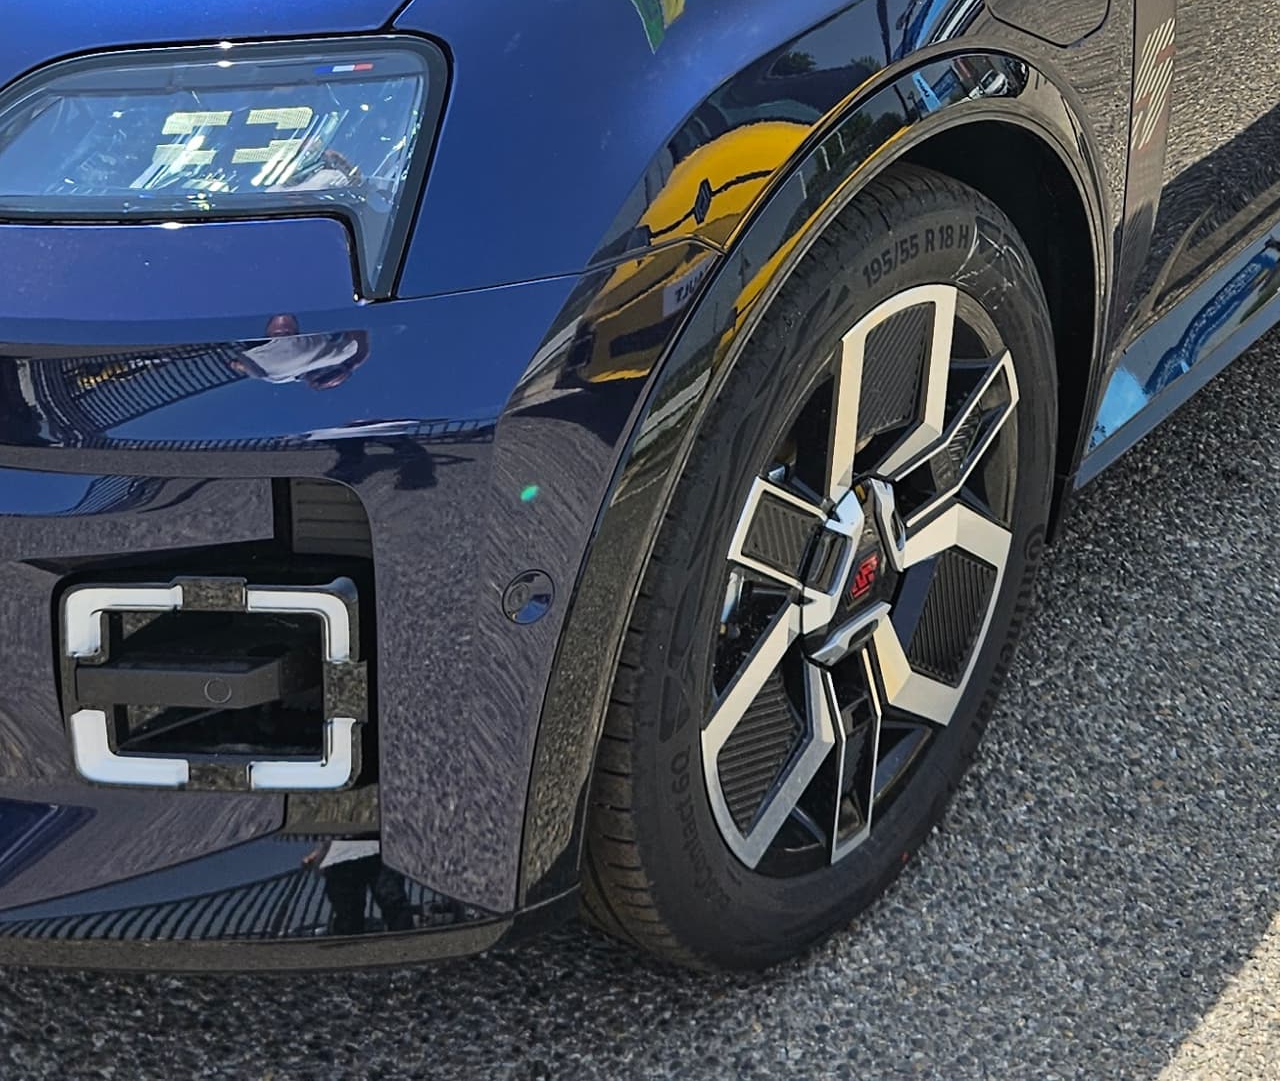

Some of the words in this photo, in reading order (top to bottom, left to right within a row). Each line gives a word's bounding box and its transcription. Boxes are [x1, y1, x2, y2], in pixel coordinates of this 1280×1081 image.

[863, 233, 919, 286] 195/55
[925, 229, 935, 253] R
[938, 225, 954, 248] 18
[958, 225, 969, 249] H
